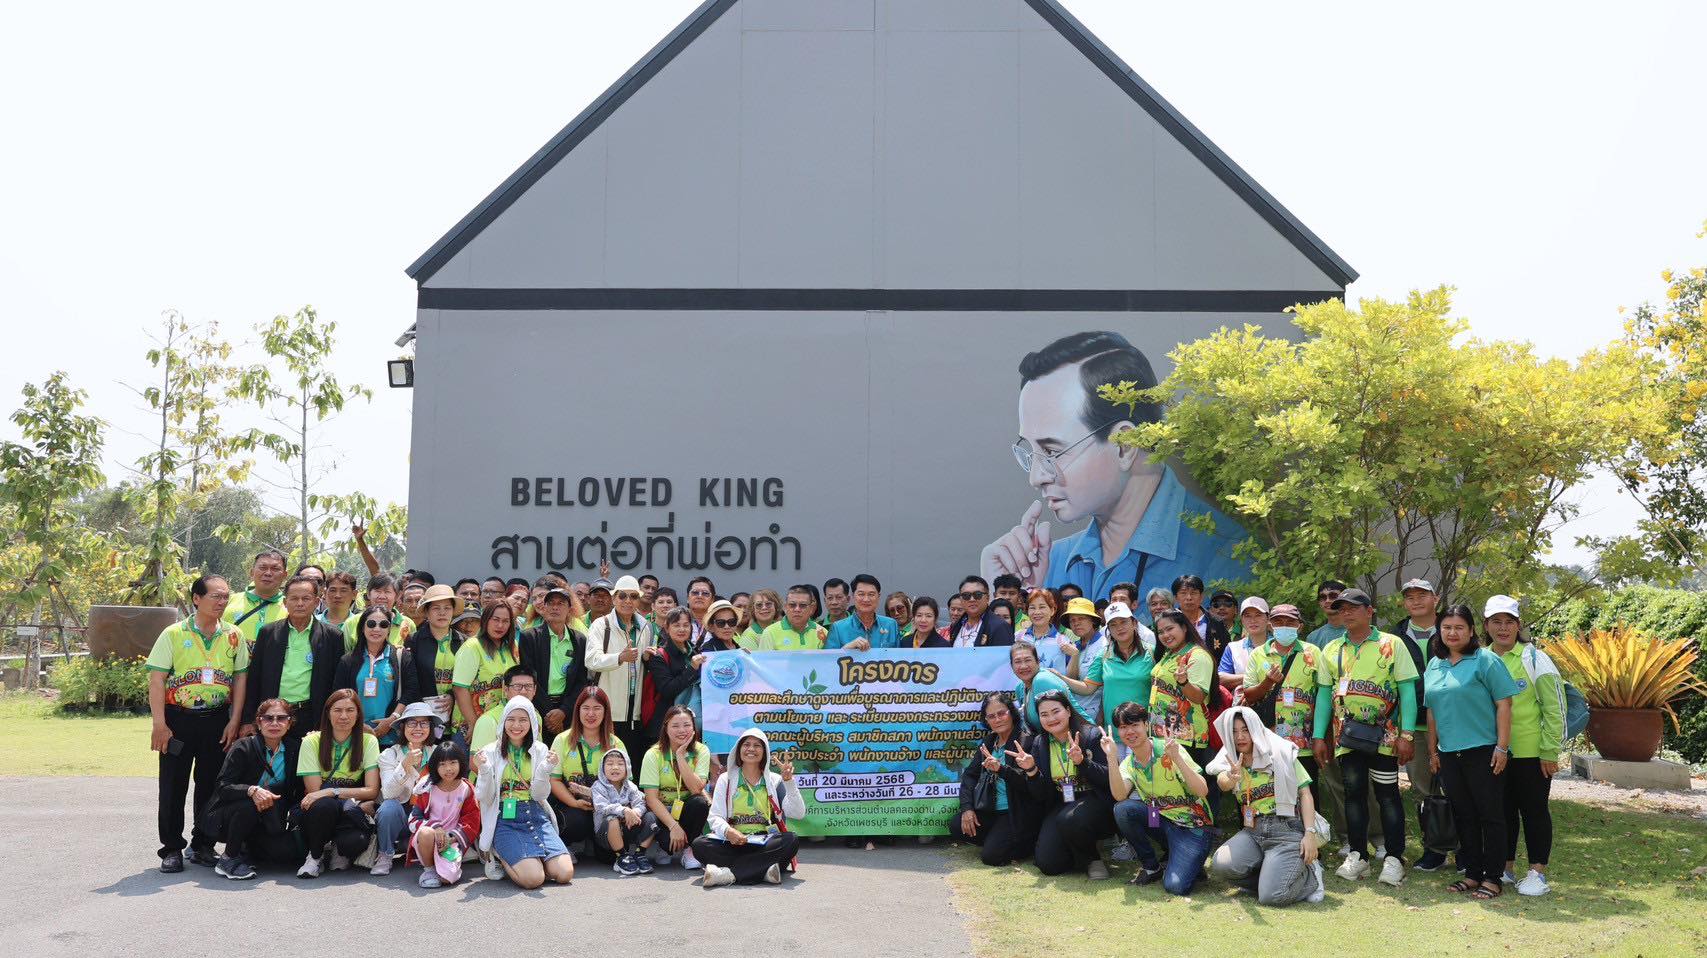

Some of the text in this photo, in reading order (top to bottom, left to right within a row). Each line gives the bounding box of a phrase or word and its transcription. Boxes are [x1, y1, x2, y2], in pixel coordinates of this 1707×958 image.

[511, 477, 784, 507] BELOVED KING
[491, 511, 801, 570] สานต่อที่พ่อทำ
[837, 656, 939, 685] โครงการ
[754, 708, 982, 724] ตามนโยบาย และ ระเบียบของกระทรวงมห
[848, 729, 912, 743] สมาชิกสภา
[849, 747, 920, 762] พนักงานจ้าง
[798, 774, 905, 786] วันที่ 20 มีนาคม 2568
[824, 786, 895, 800] และระหว่างวันที่
[899, 787, 913, 797] 26
[925, 786, 939, 796] 28
[805, 803, 935, 816] ค์การบริหารส่วนตำบลคลองด่าน
